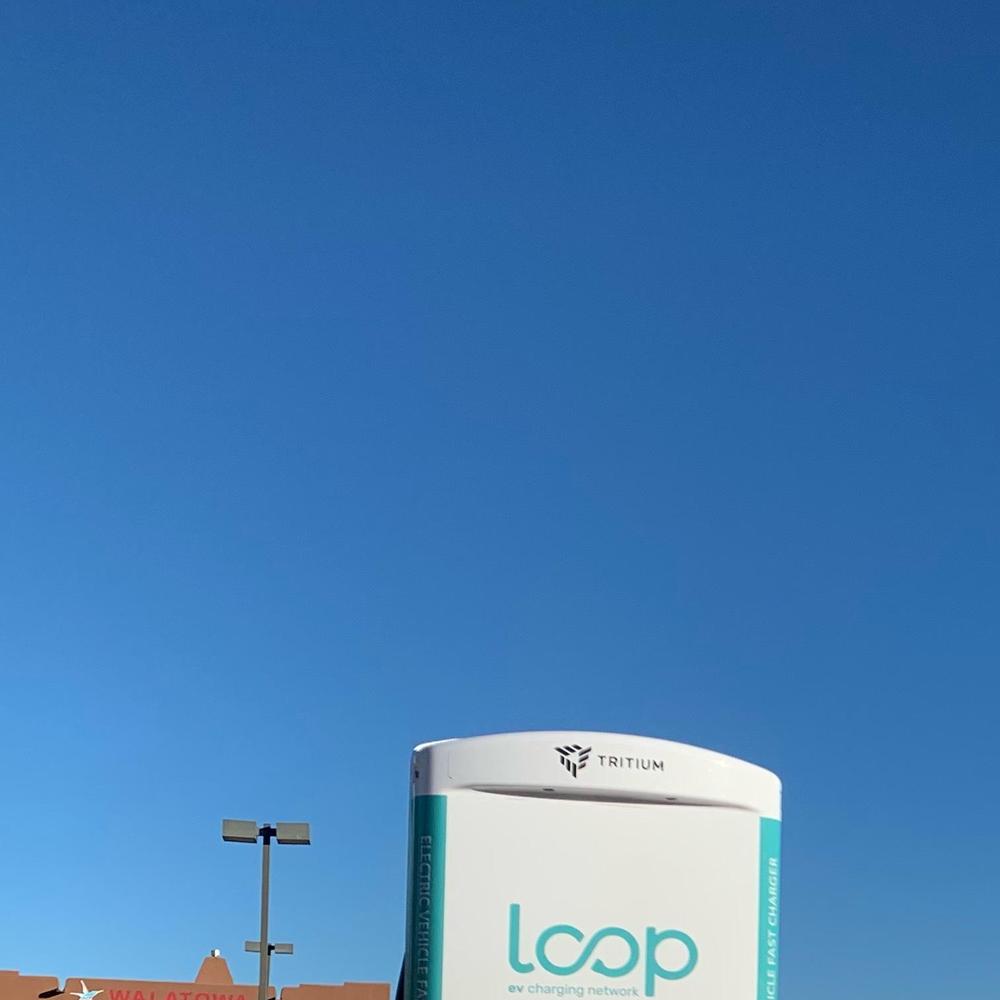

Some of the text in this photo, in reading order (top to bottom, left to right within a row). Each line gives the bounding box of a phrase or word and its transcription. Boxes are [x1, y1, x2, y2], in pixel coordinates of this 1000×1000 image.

[598, 754, 665, 772] TRITIUM
[418, 835, 432, 906] ELECTRIC
[767, 857, 778, 926] CHARGER
[417, 909, 430, 974] VEHICLE
[508, 903, 698, 997] loop
[767, 929, 777, 965] FAST
[508, 983, 640, 998] ev charging network
